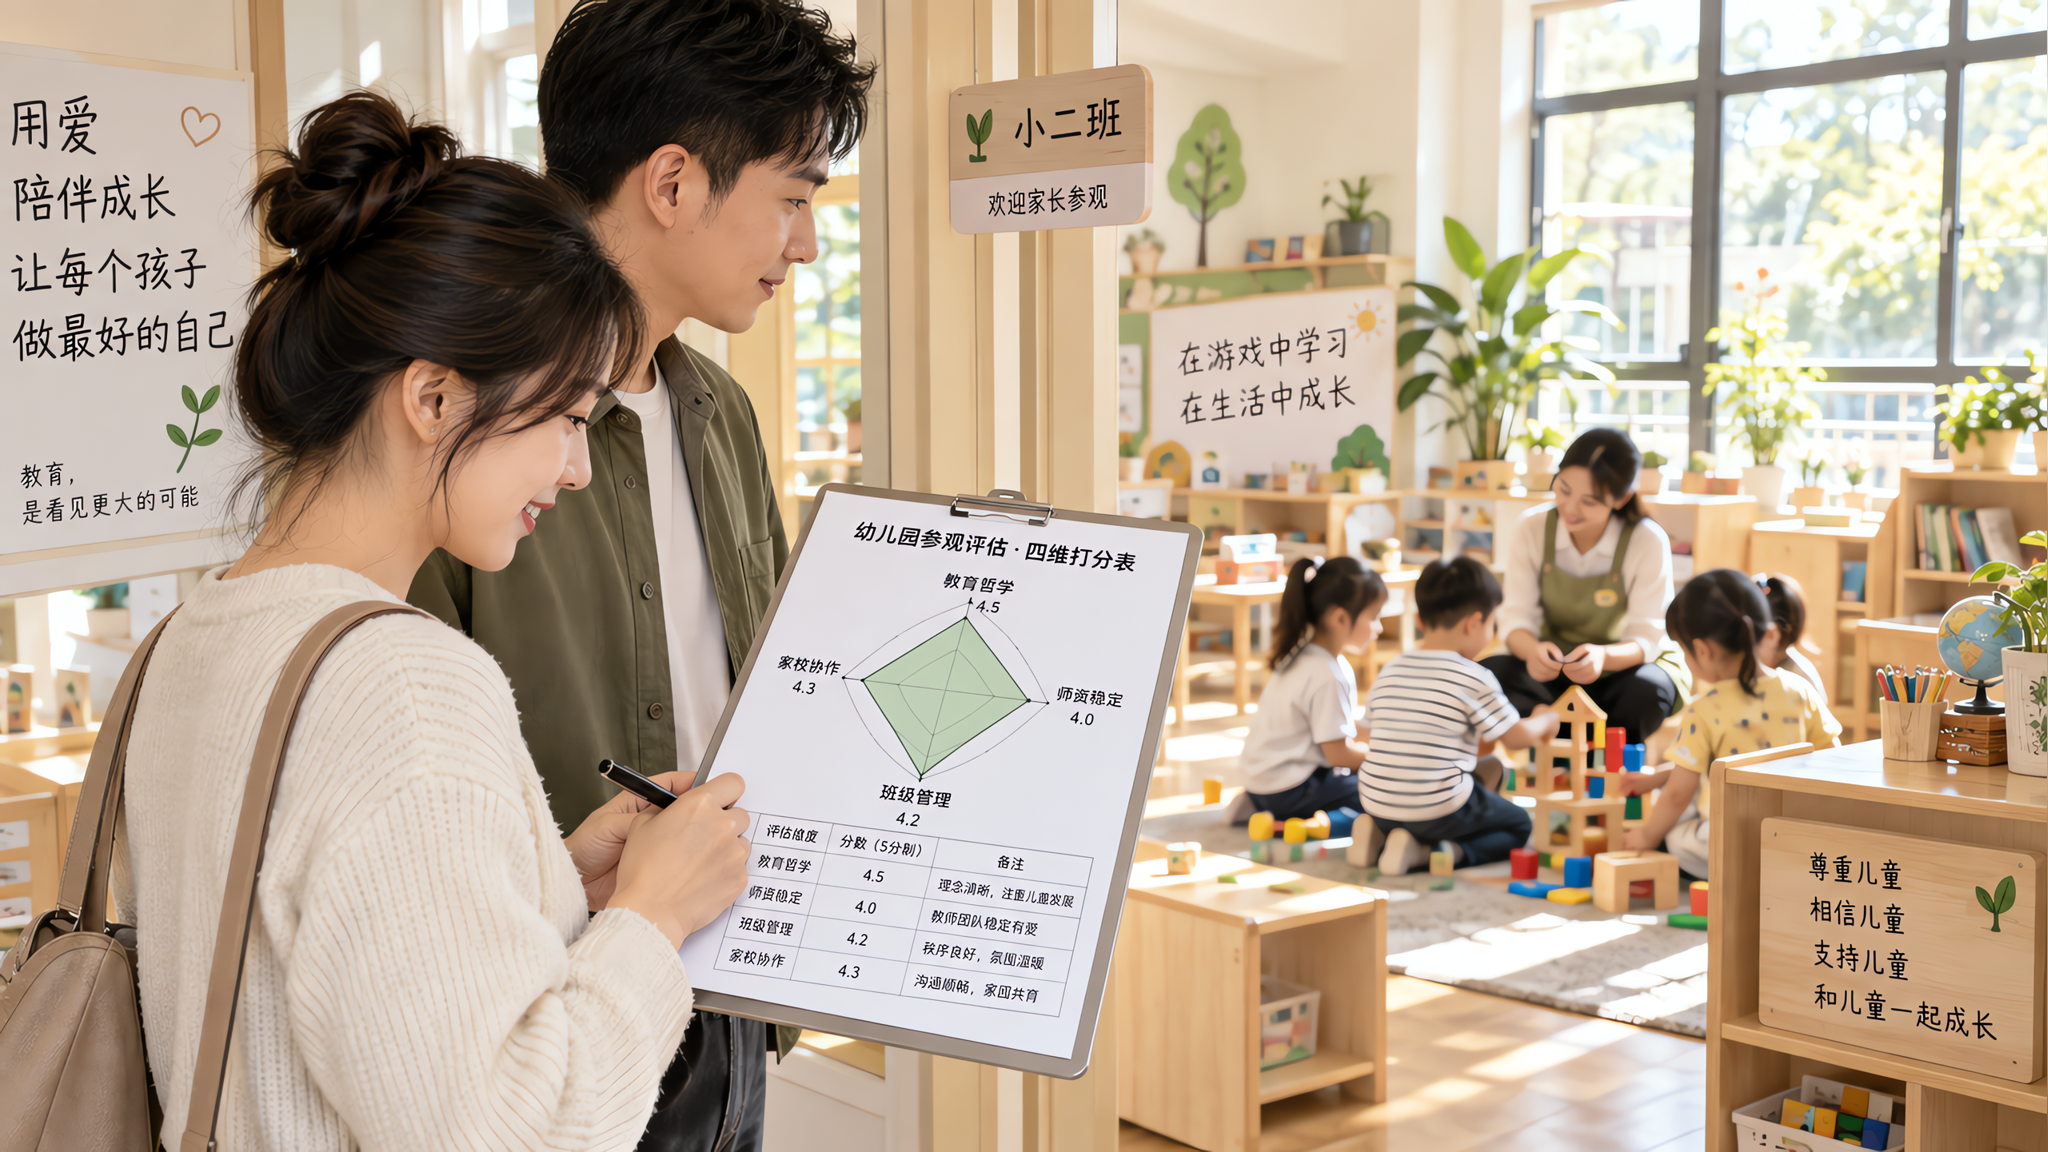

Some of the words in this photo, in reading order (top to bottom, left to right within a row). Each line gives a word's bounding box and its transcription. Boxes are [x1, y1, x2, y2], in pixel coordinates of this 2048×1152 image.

[11, 94, 98, 155] 用爱
[1014, 97, 1122, 149] 小二班
[13, 173, 176, 224] 陪伴成长
[988, 183, 1108, 217] 欢迎家长参观
[10, 246, 207, 297] 让每个孩子
[12, 309, 235, 362] 做最好的自己
[1179, 326, 1346, 377] 在游戏中学习
[1181, 373, 1355, 424] 在生活中成长
[20, 461, 74, 489] 教育，
[22, 483, 199, 525] 是看见更大的可能
[975, 600, 1001, 614] 4.5
[792, 680, 816, 695] 4.3
[1069, 711, 1095, 726] 4.0
[895, 811, 921, 827] 4.2
[862, 869, 885, 883] 4.5
[1809, 851, 1902, 891] 尊重儿童
[854, 900, 877, 915] 4.0
[1810, 896, 1905, 935] 相信儿童
[846, 932, 869, 947] 4.2
[838, 964, 861, 979] 4.3
[1814, 939, 1909, 981] 支持儿童
[1814, 983, 1997, 1041] 和儿童一起成长
